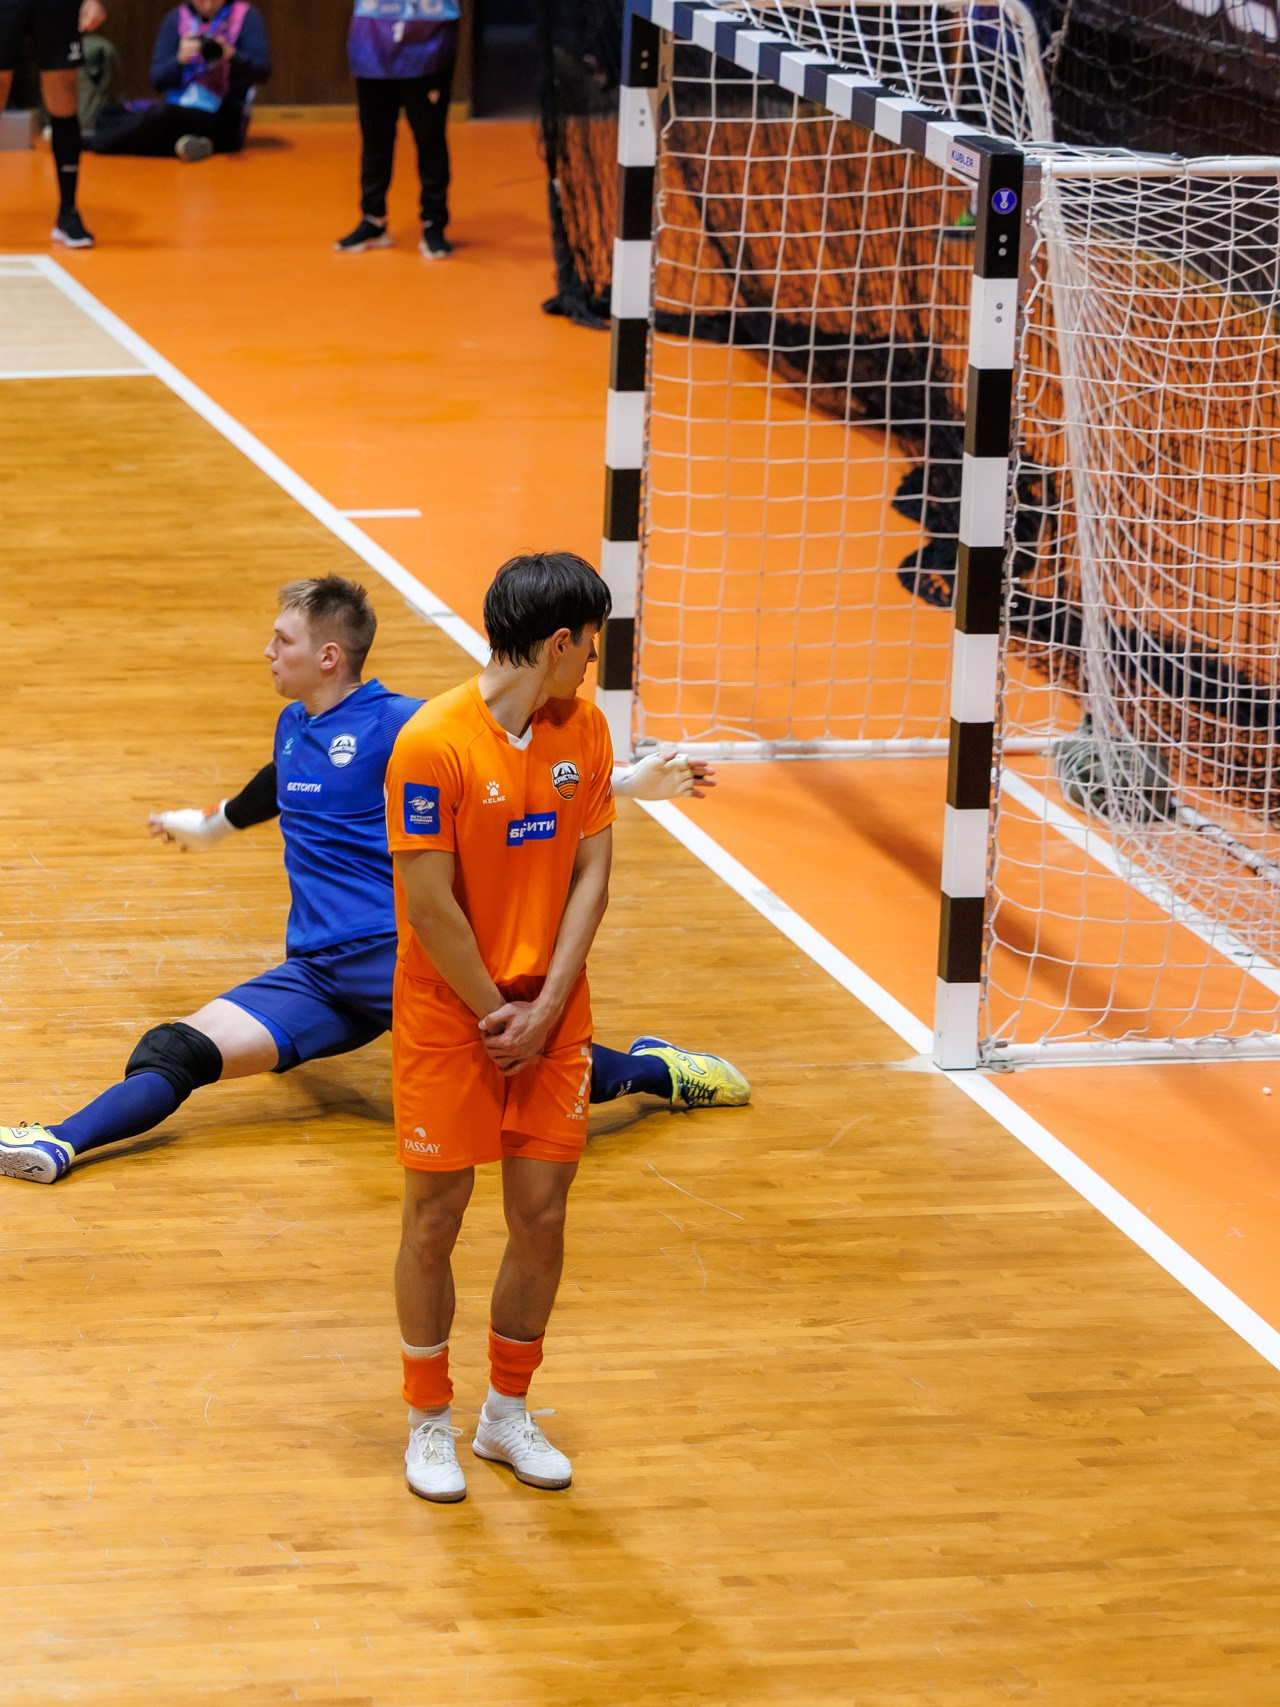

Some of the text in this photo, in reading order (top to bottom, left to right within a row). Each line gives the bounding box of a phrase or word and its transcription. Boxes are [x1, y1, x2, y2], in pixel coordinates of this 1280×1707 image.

[286, 782, 322, 793] БЕТСИТИ
[482, 795, 507, 805] KELME
[403, 1138, 441, 1154] TASSAY
